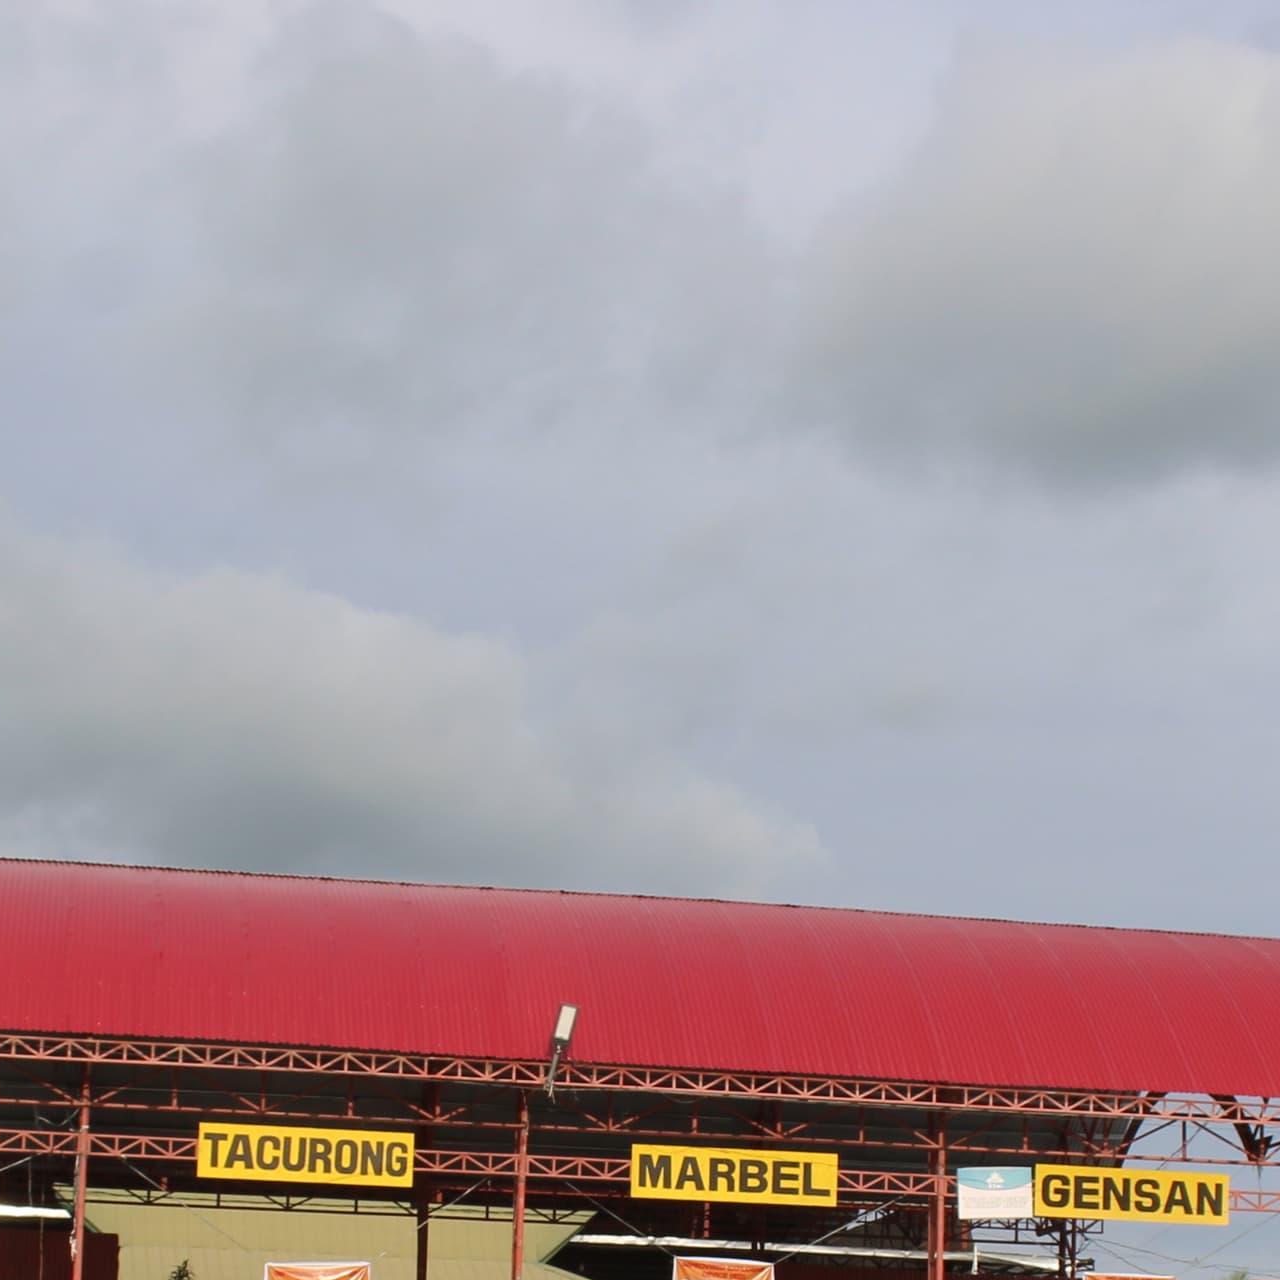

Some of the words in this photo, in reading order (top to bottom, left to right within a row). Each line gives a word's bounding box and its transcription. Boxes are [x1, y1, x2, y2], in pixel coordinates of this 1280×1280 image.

[204, 1132, 408, 1177] TACURONG
[638, 1154, 830, 1197] MARBEL
[1041, 1174, 1223, 1216] GENSAN
